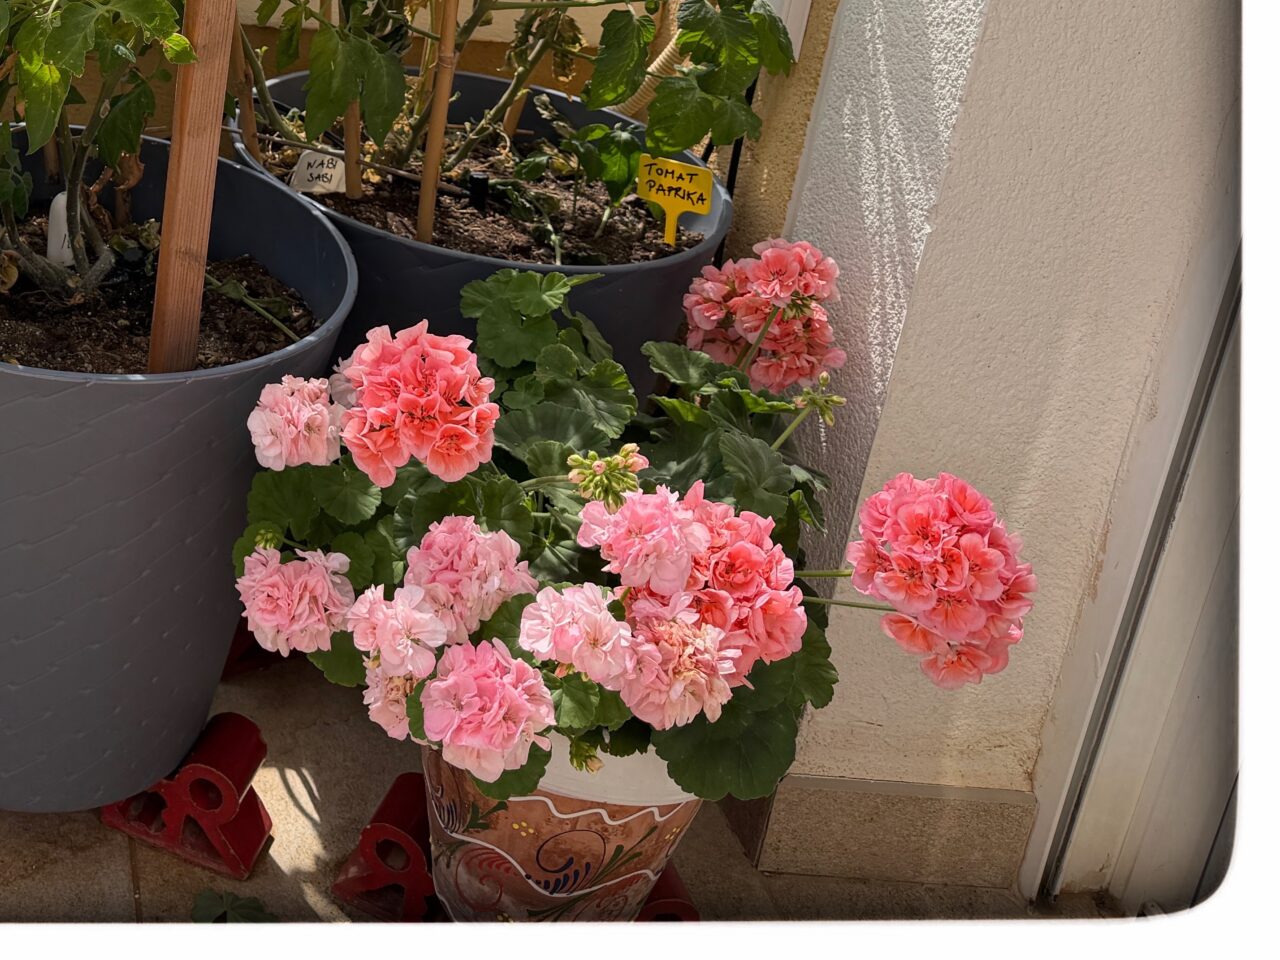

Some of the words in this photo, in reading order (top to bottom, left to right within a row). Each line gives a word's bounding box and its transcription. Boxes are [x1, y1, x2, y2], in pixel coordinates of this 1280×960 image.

[307, 172, 333, 185] SABI
[644, 162, 699, 184] TOMAT
[645, 179, 707, 206] PAPRIKA
